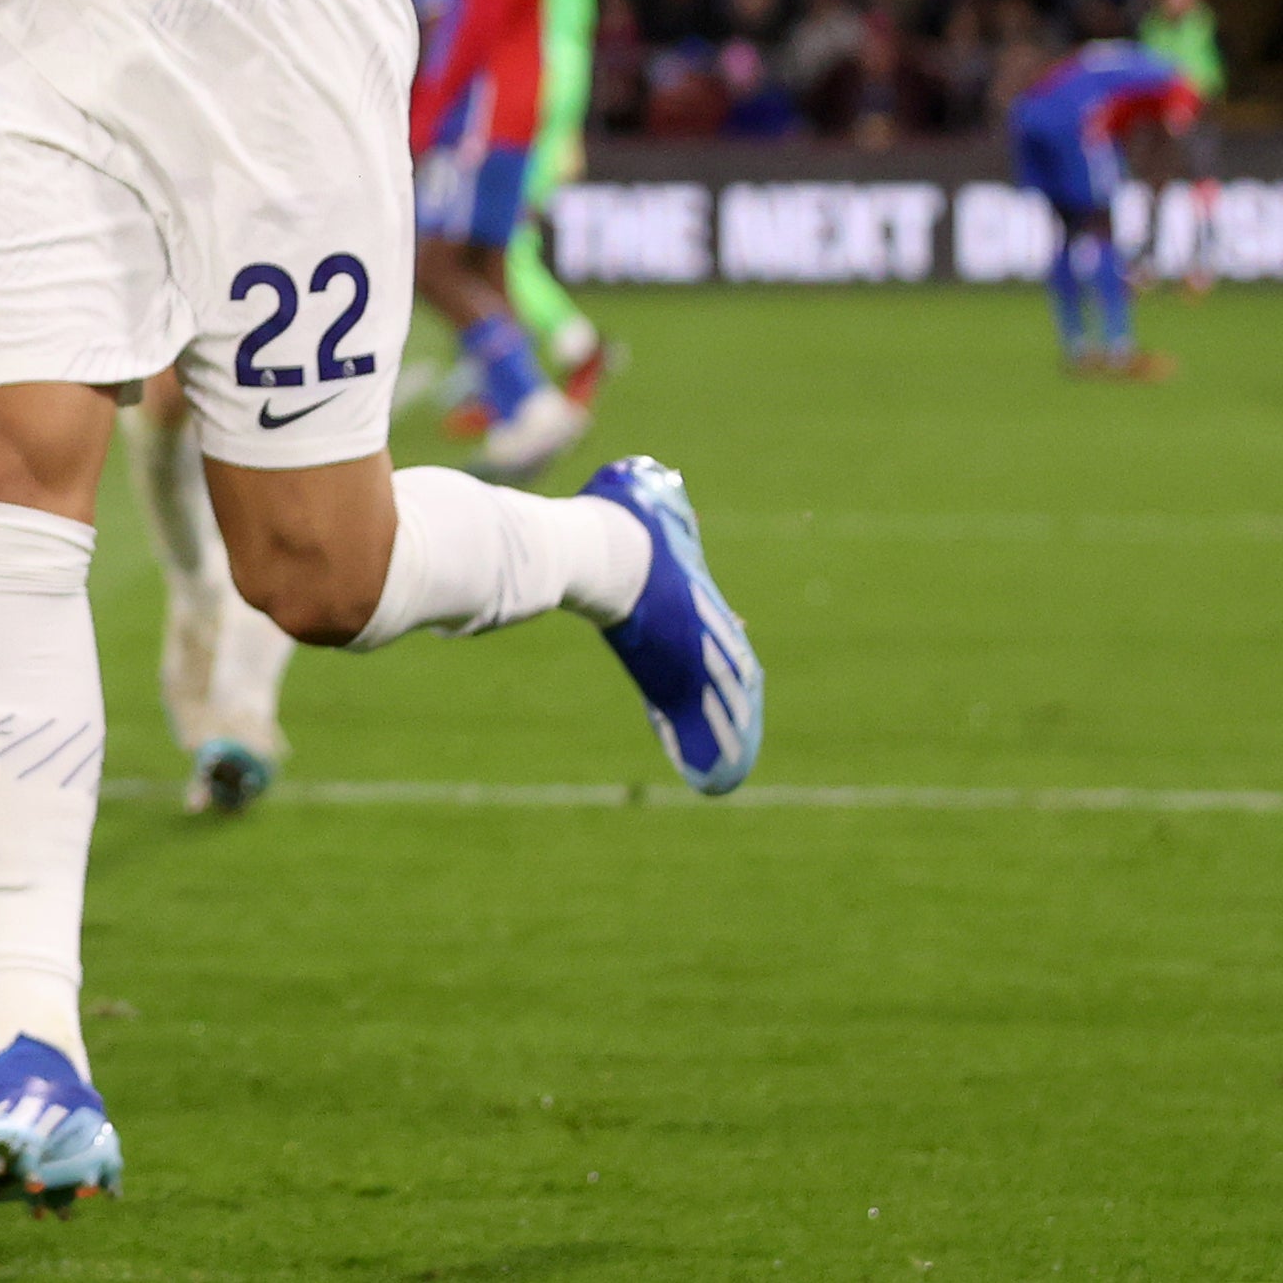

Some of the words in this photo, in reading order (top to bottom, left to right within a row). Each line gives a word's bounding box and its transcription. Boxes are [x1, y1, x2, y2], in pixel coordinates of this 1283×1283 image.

[557, 183, 712, 281] THE
[718, 183, 947, 281] NEXT
[229, 251, 376, 388] 22
